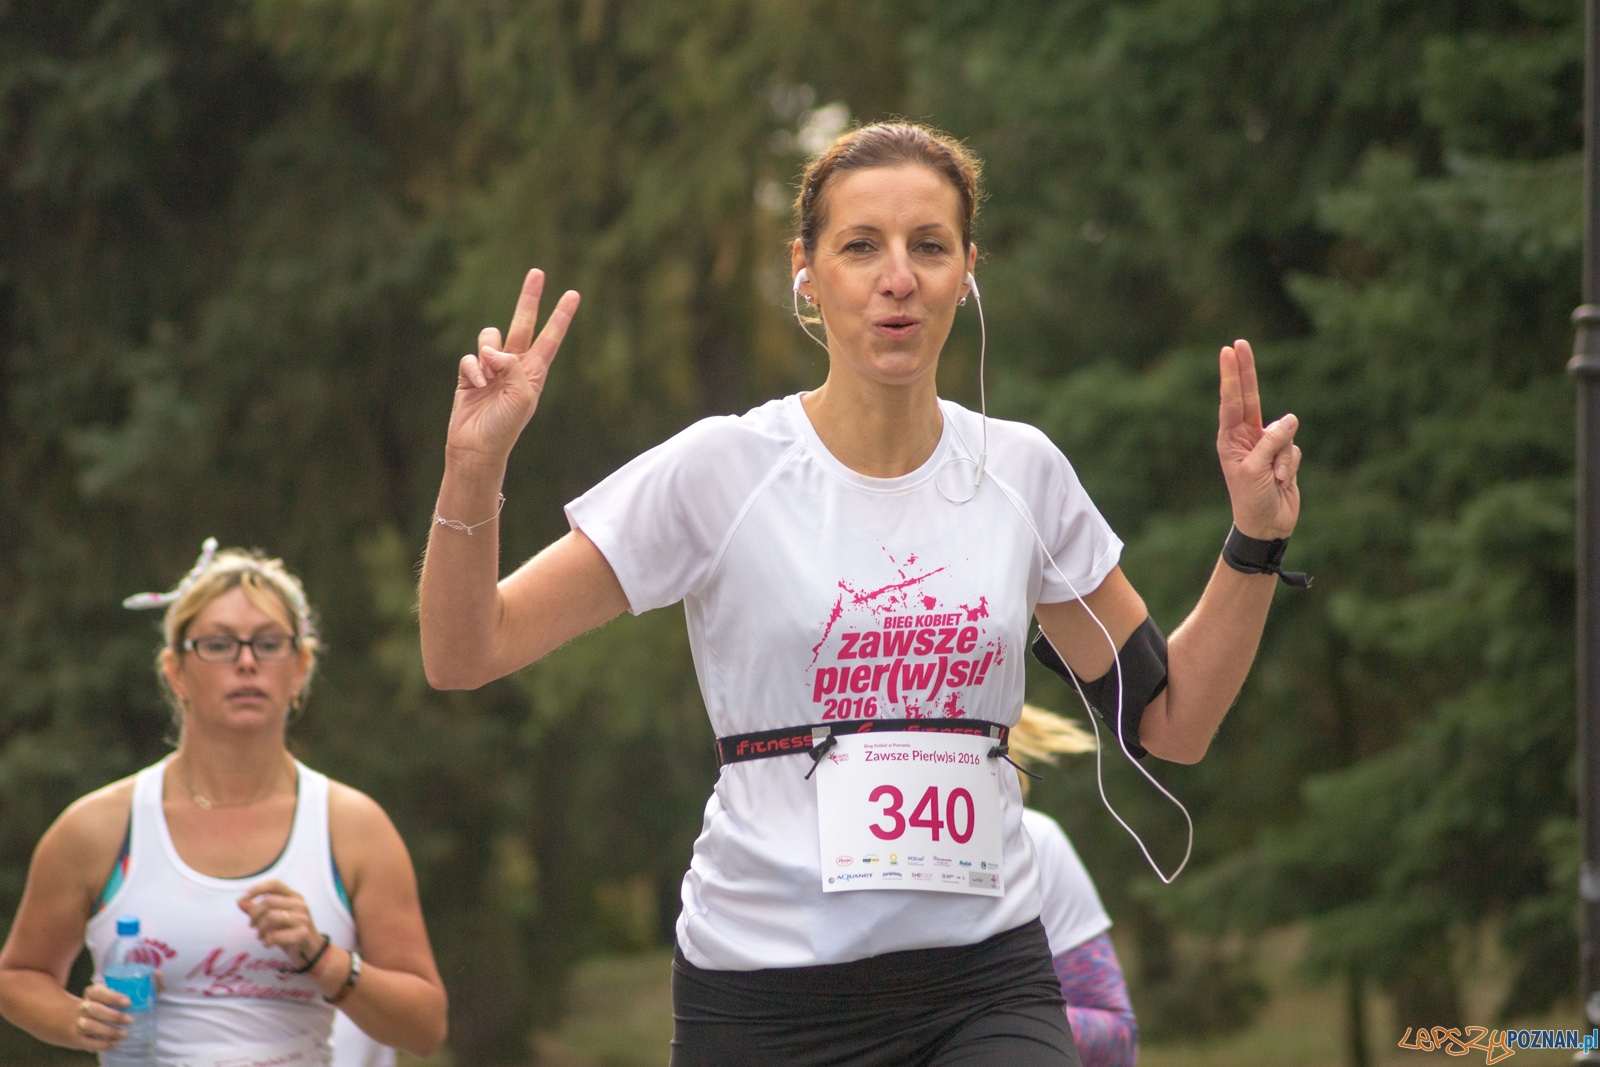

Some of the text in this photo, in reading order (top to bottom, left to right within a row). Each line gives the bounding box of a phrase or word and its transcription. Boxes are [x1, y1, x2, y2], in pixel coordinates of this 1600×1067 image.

[883, 613, 962, 629] BIEG KOBIET
[837, 626, 978, 660] zawsze
[822, 696, 878, 720] 2016
[864, 750, 909, 762] Zawsze
[912, 750, 956, 764] Pier(w)si
[958, 752, 980, 765] 2016
[868, 784, 975, 844] 340
